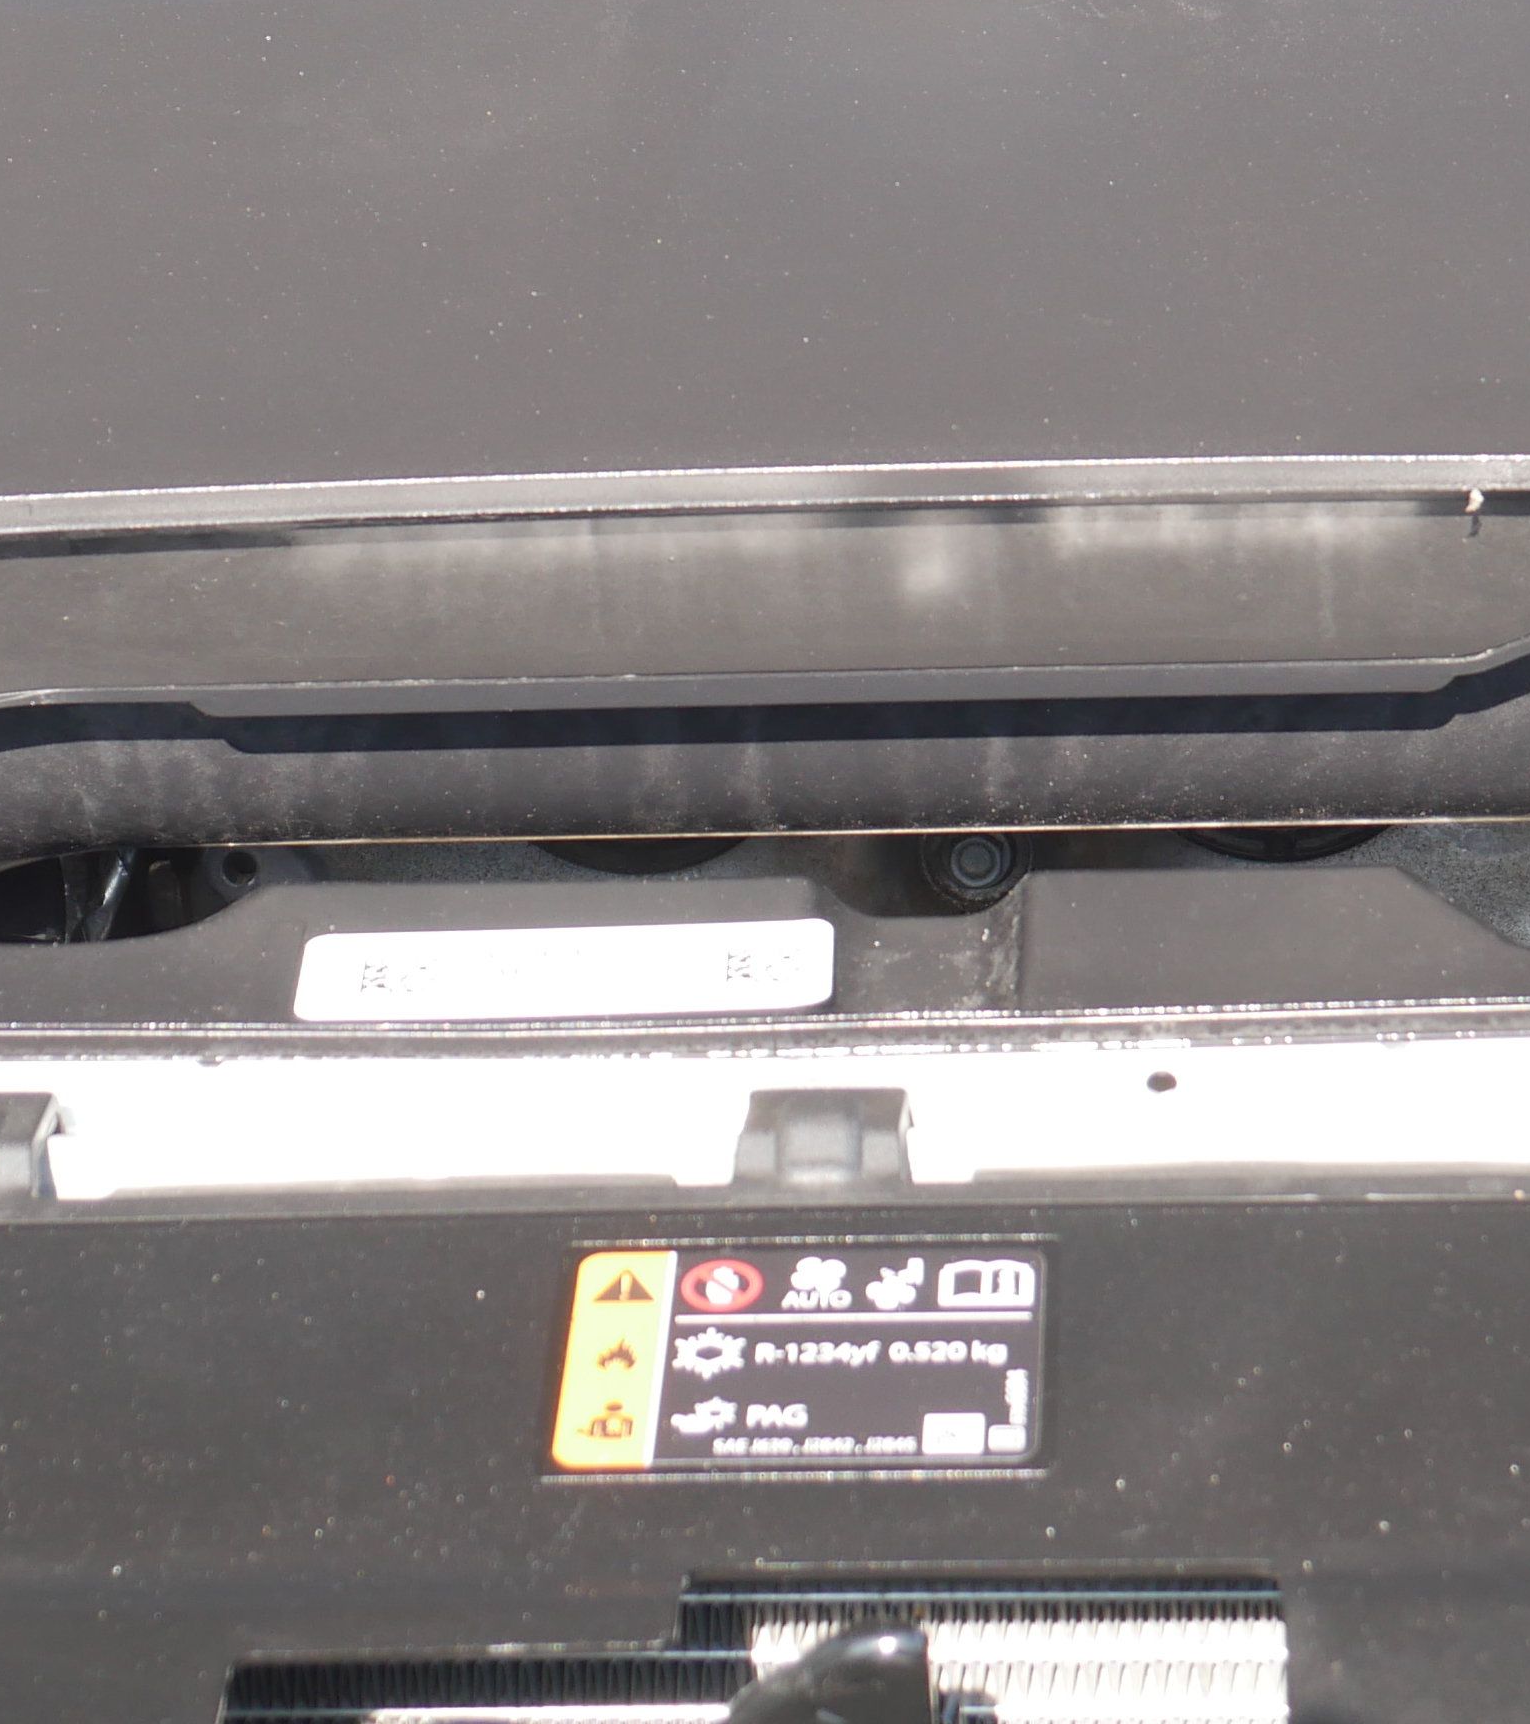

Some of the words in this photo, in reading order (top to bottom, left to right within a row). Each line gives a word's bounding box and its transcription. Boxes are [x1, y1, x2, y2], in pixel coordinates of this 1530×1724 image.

[781, 1290, 852, 1309] AUTO
[888, 1340, 968, 1364] 0.520
[971, 1339, 1008, 1367] kg
[746, 1403, 808, 1429] PAG
